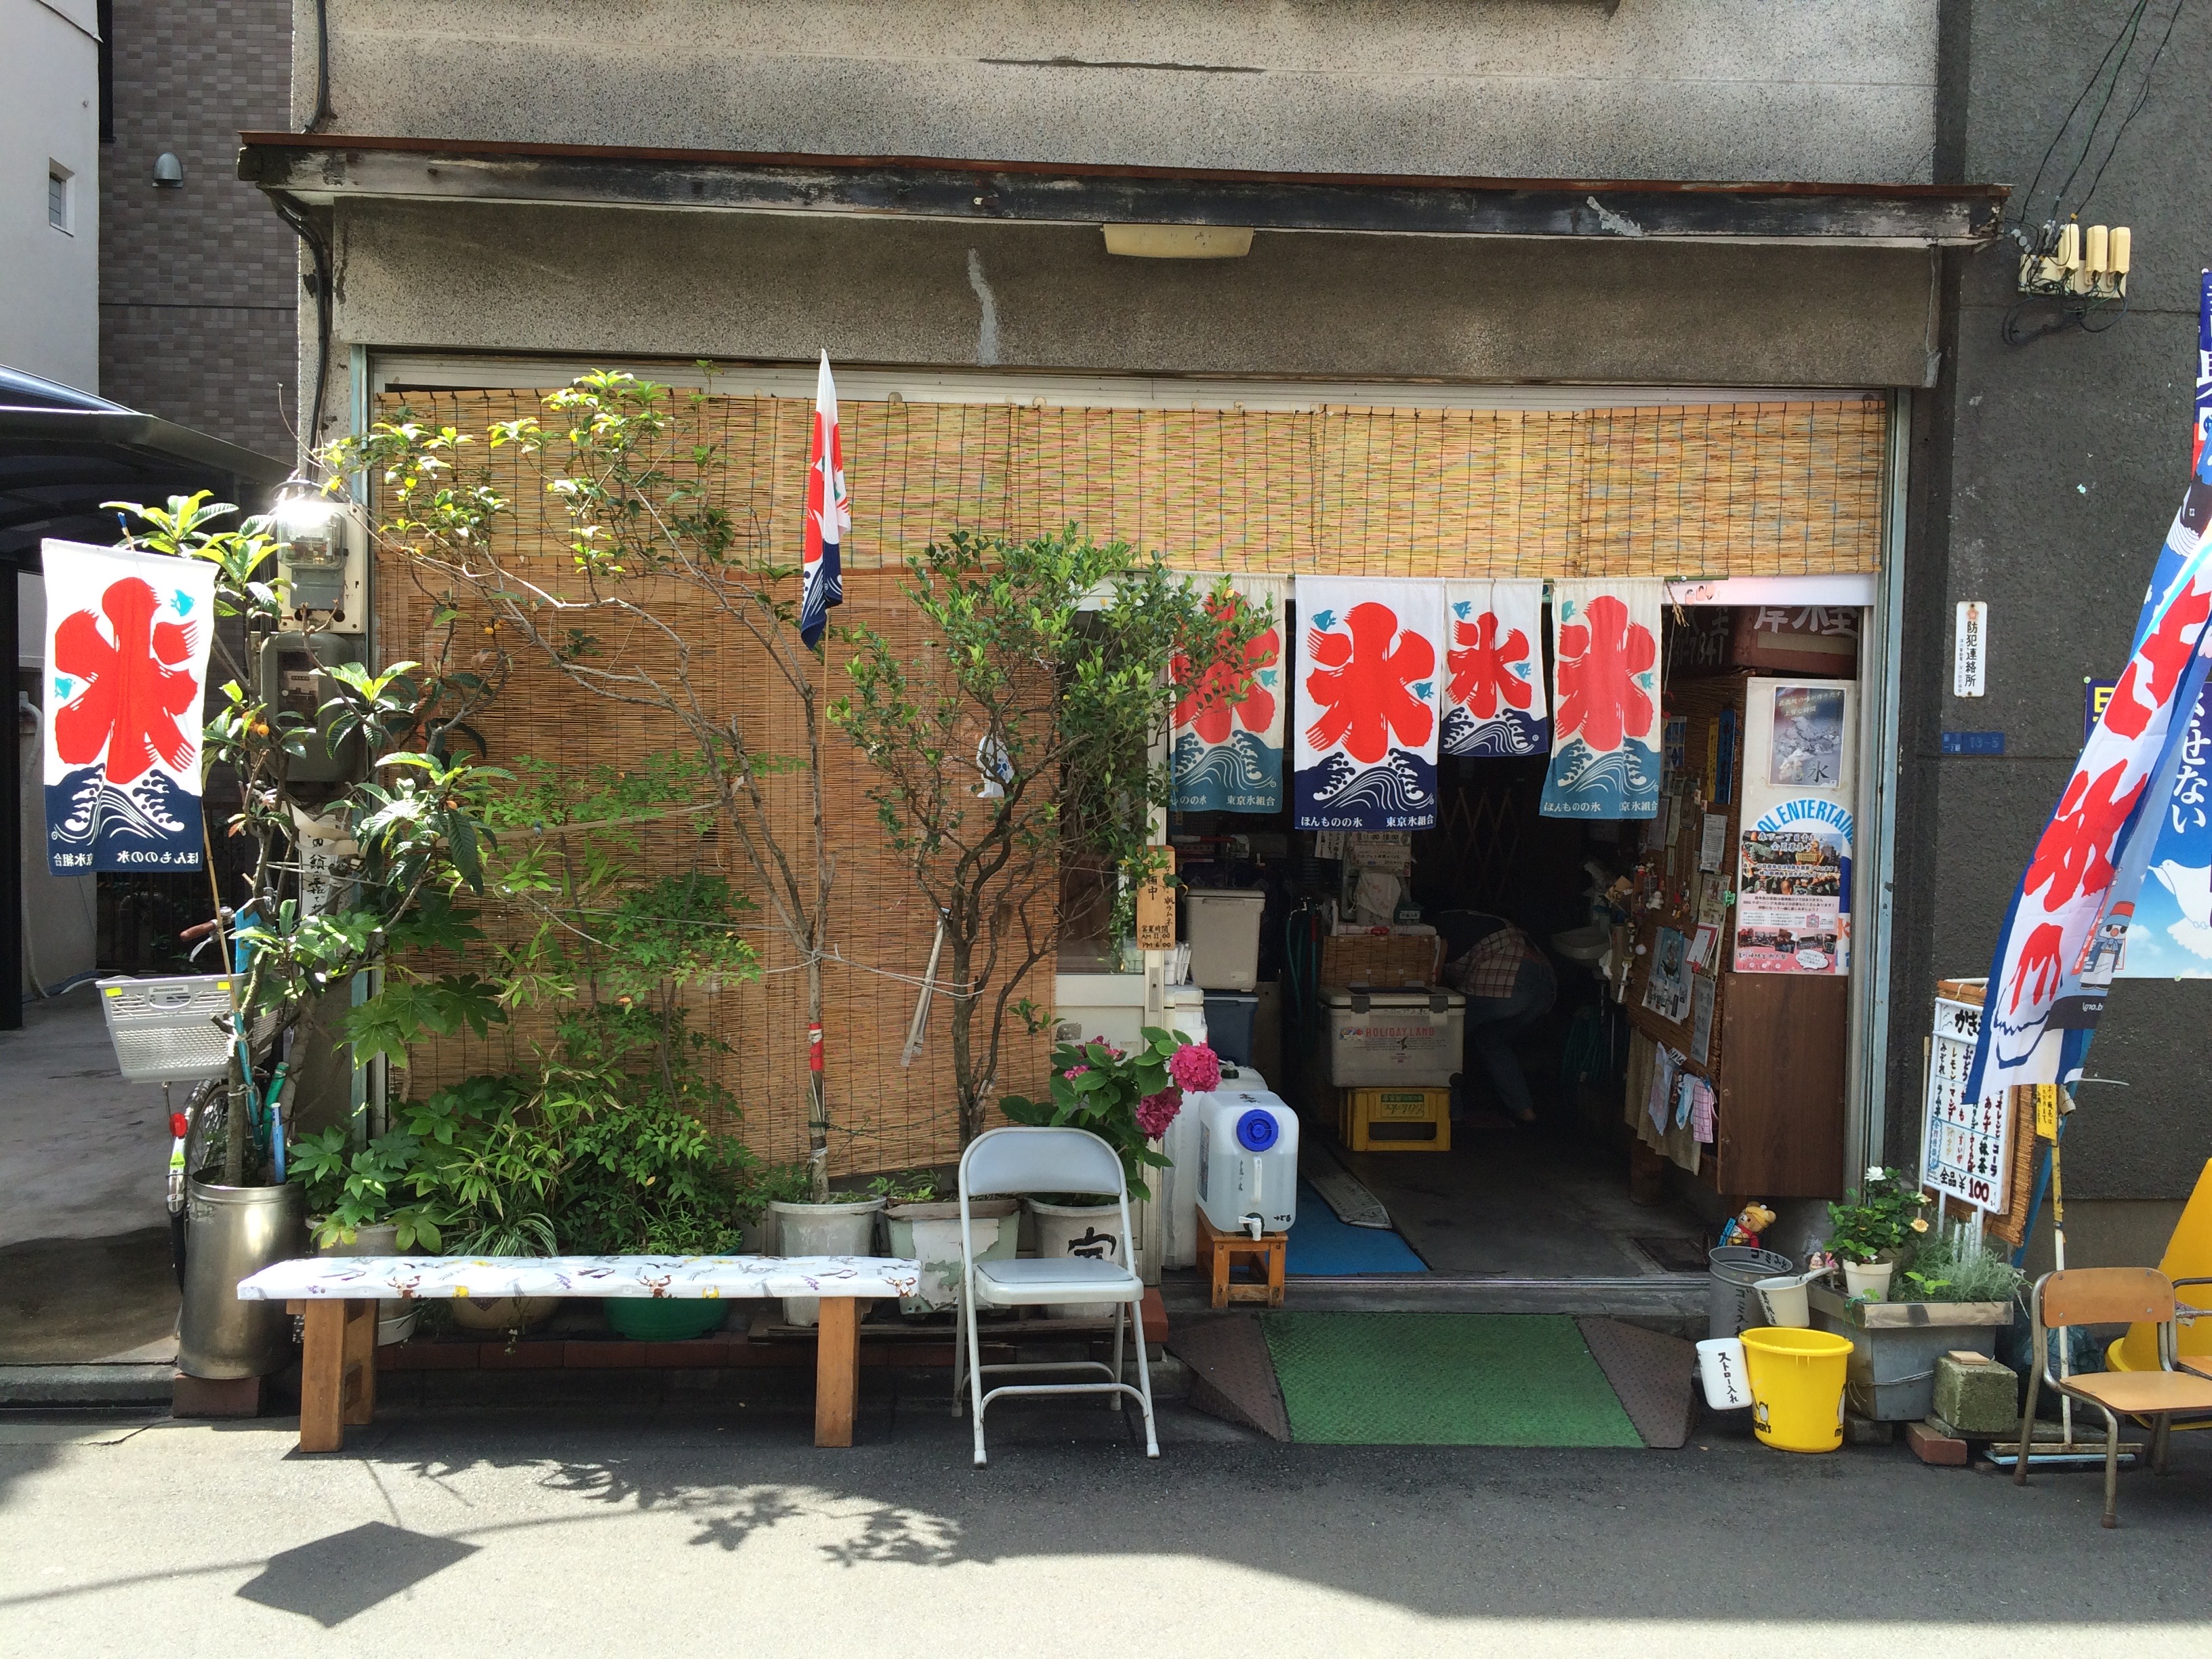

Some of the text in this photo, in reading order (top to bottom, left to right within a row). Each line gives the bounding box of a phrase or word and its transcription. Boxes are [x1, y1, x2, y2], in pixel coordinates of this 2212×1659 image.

[1448, 611, 1532, 720] 氷
[1965, 621, 1978, 687] 防犯連絡所
[1307, 602, 1435, 764] 氷
[1556, 595, 1655, 752] 氷
[1227, 795, 1275, 806] 東京氷組合
[1544, 802, 1601, 813] ほんものの氷
[1300, 814, 1434, 827] ほんものの氷 東京氷組合
[1366, 1027, 1435, 1038] HOLIDAY LAND
[1954, 1009, 1983, 1037] かき
[1939, 1043, 1947, 1075] みぞれ
[1963, 1044, 1973, 1082] ぶどう
[1933, 1084, 1943, 1118] ラムネ
[1978, 1141, 1990, 1174] 抹茶
[1990, 1144, 1999, 1178] コーラ
[1717, 1352, 1739, 1404] ストロー入れ
